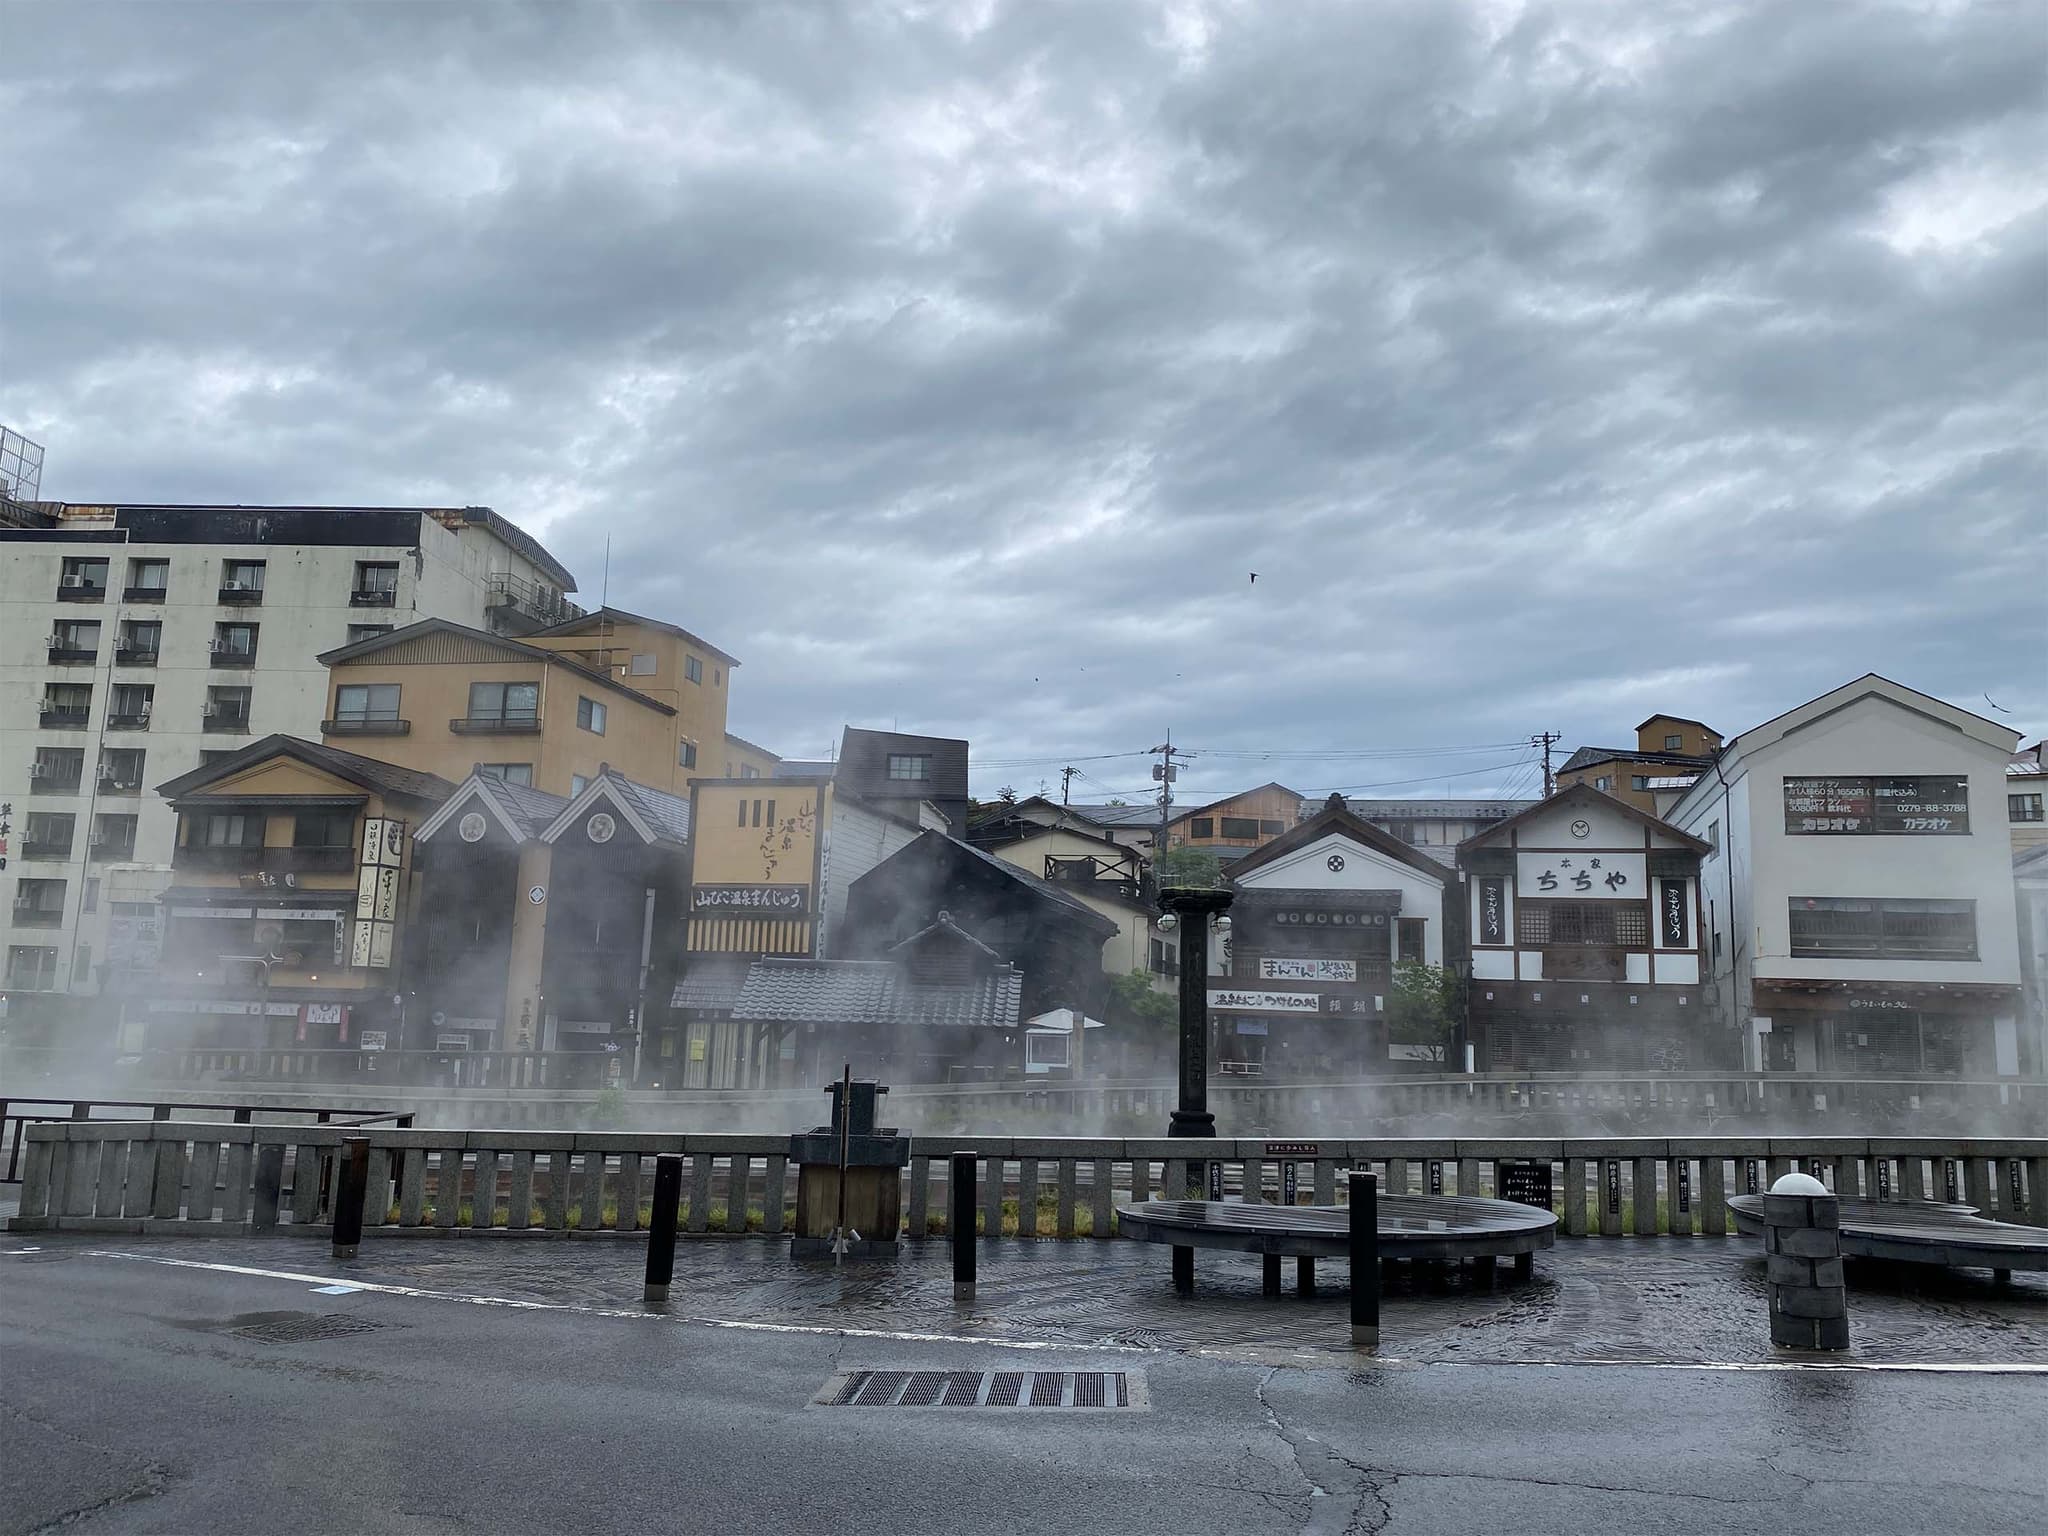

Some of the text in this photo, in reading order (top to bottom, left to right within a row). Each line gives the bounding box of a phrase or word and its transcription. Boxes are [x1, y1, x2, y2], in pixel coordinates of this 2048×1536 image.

[1896, 804, 1967, 813] 0279-88-3788
[1802, 817, 1860, 831] カラオケ
[1903, 817, 1952, 830] カラオケ
[1561, 857, 1601, 869] 本家
[1536, 869, 1628, 892] ちちや
[696, 888, 802, 908] 山びこ温泉まんじゅう
